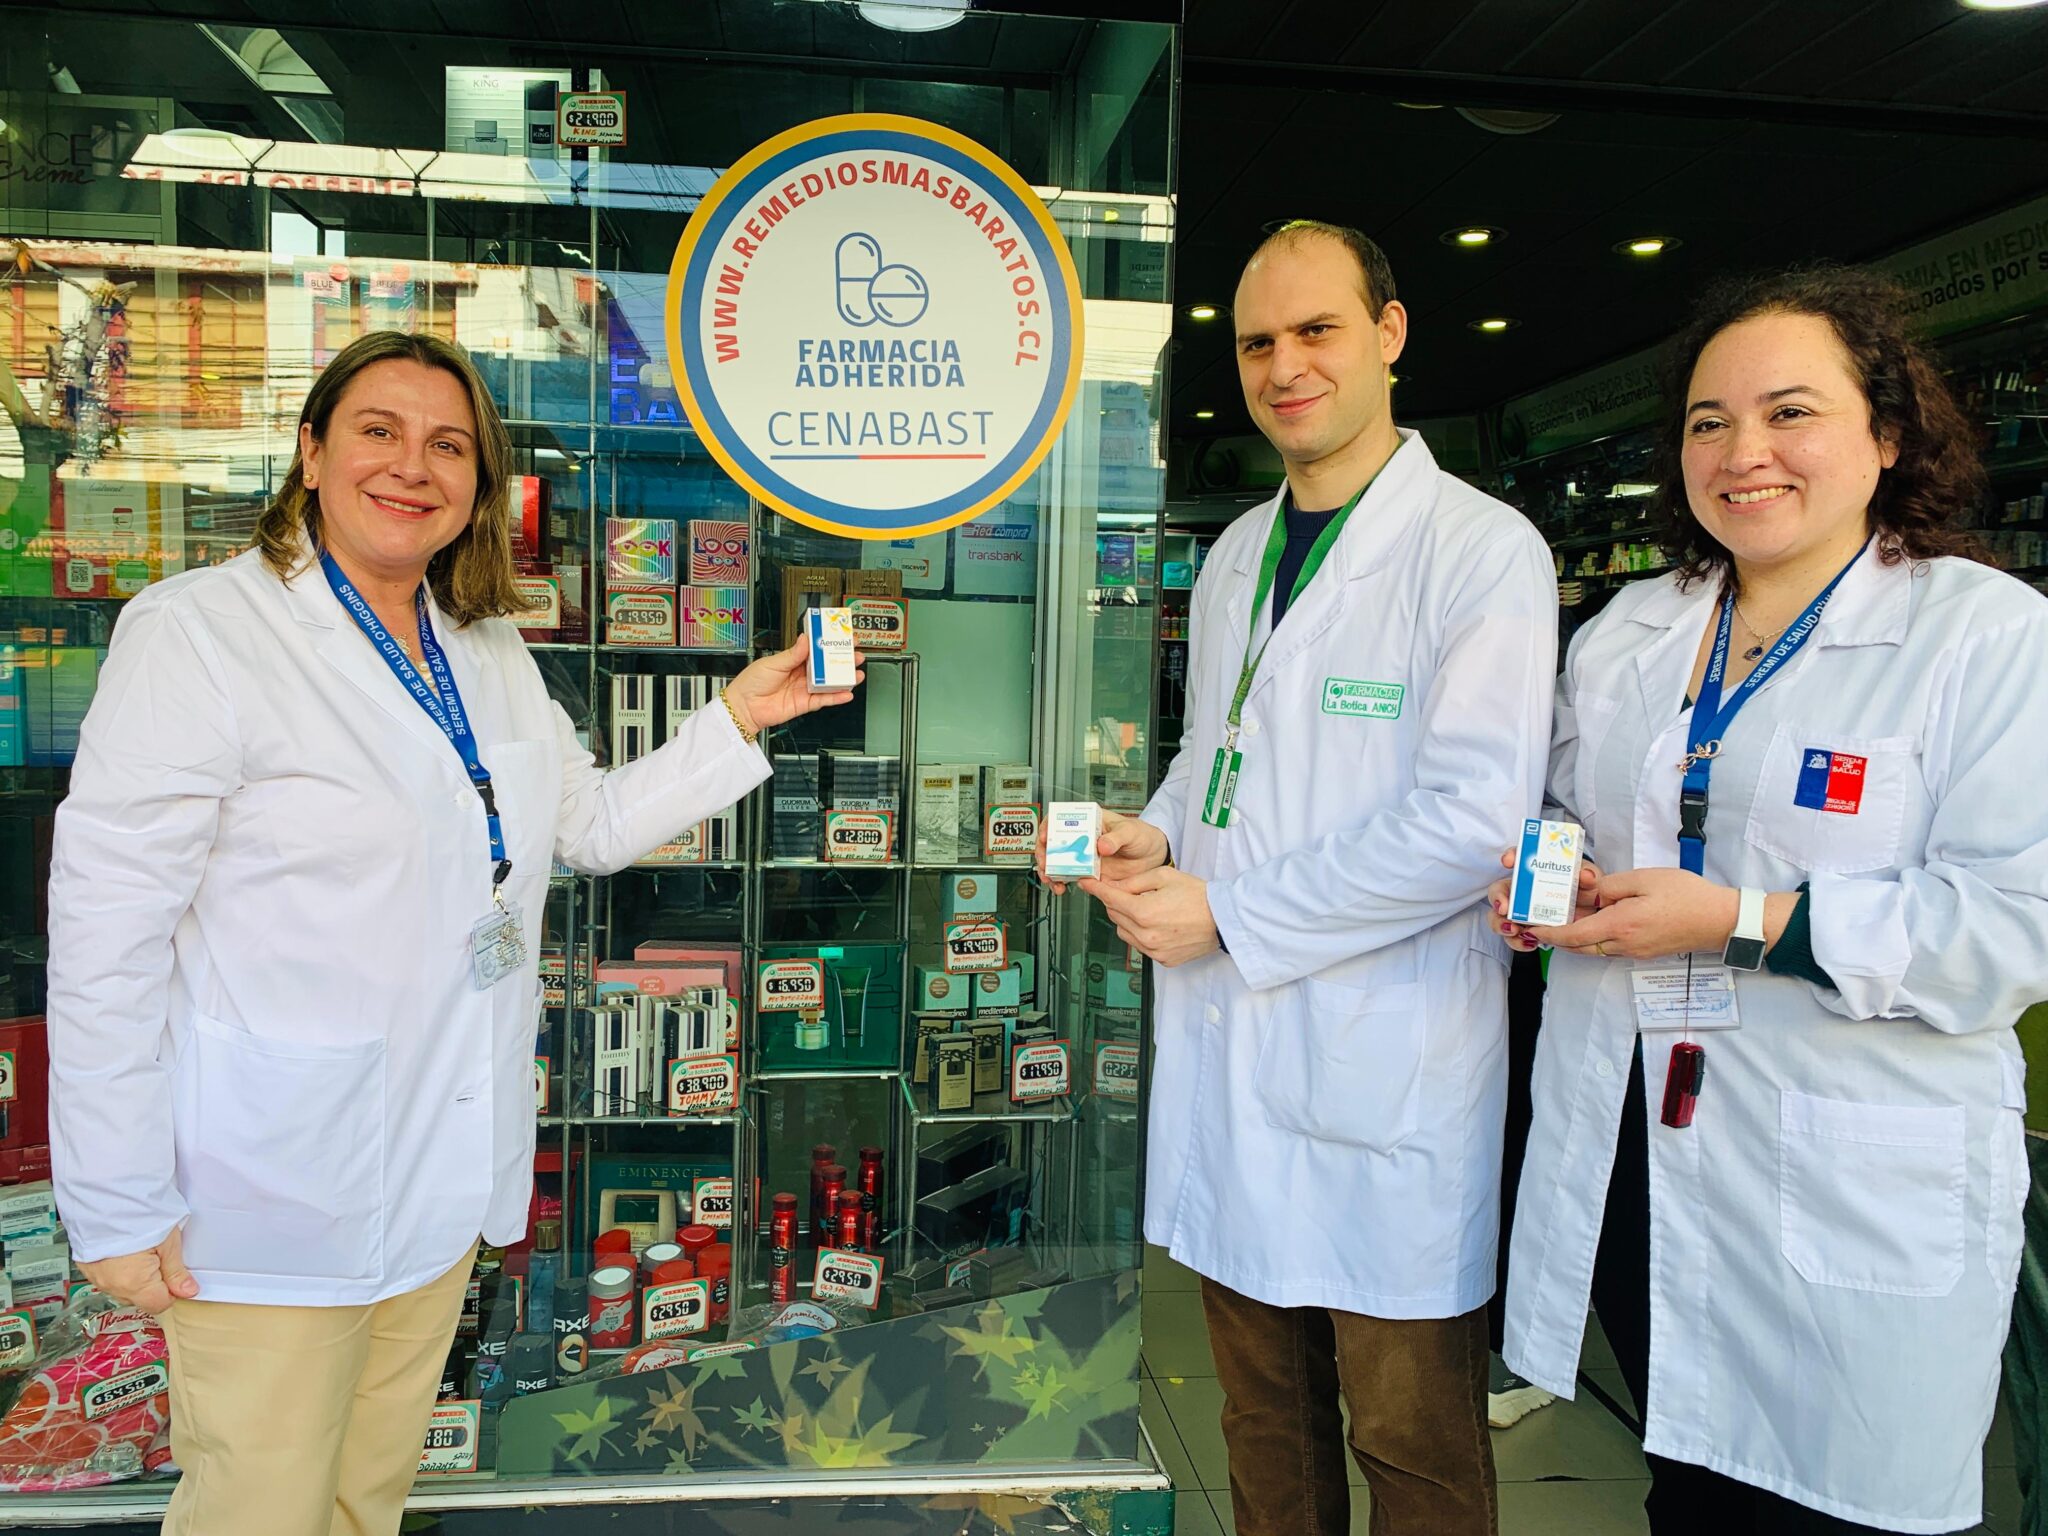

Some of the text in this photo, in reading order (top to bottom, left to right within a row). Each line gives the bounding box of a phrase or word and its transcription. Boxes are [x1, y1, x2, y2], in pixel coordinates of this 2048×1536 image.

[473, 79, 499, 88] KING
[573, 127, 598, 136] KING
[714, 160, 1042, 367] WWW.REMEDIOSMASBARATOS.CL
[1946, 247, 1978, 276] EN
[1992, 256, 2030, 291] por
[311, 279, 334, 289] BLUE
[799, 339, 960, 363] FARMACIA
[795, 364, 965, 388] ADHERIDA
[1576, 409, 1589, 422] en
[768, 410, 993, 446] CENABAST
[608, 540, 671, 557] LOOK
[339, 584, 386, 640] O'HIGGINS
[684, 607, 745, 624] LOOK
[819, 639, 852, 647] Aerovial
[1745, 614, 1818, 688] SEREMI DE SALUD
[383, 642, 415, 679] SALUD
[1709, 651, 1724, 683] SEREMI
[410, 680, 427, 698] DE
[424, 643, 466, 735] SEREMI DE SALUD
[1344, 684, 1400, 700] FARMACIAS
[1326, 698, 1398, 714] La Botica ANICH
[1832, 765, 1861, 776] SALUD
[1531, 859, 1572, 872] Aurituss
[680, 1092, 717, 1105] TOMMY
[619, 1167, 702, 1178] EMINENCE
[554, 1314, 590, 1332] AXE
[477, 1340, 506, 1356] XE
[516, 1378, 548, 1390] AXE
